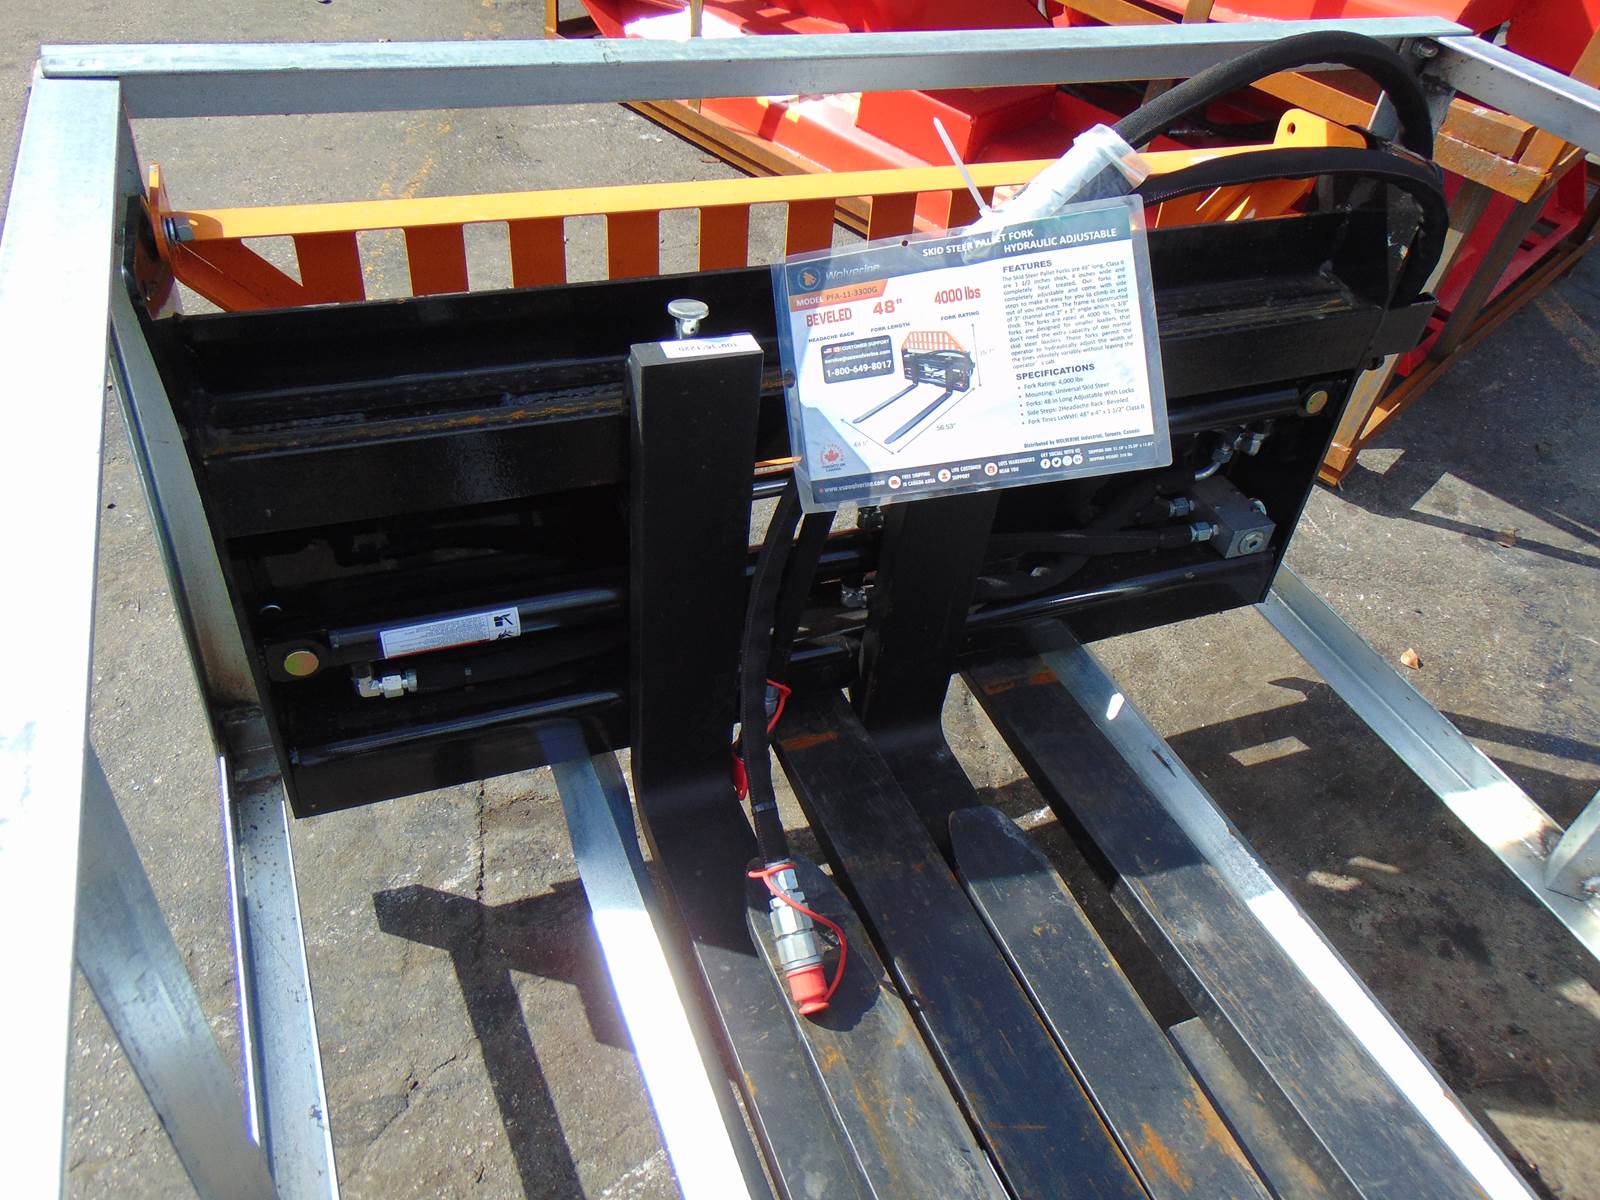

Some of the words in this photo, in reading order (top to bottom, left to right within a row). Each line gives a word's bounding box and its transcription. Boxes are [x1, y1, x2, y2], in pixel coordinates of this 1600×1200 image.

[923, 247, 944, 257] SKID
[945, 240, 973, 254] STEER
[1008, 229, 1034, 241] FORK
[1004, 236, 1057, 253] HYDRAULIC
[1059, 228, 1117, 244] ADJUSTABLE
[826, 264, 880, 280] Wolverine
[1003, 260, 1052, 273] FEATURES
[796, 296, 824, 307] MODEL
[934, 288, 963, 304] 4000
[964, 286, 981, 300] lbs
[806, 307, 852, 327] BEVELED
[887, 322, 911, 330] LENGTH
[808, 335, 838, 343] HEADACHE
[842, 343, 867, 351] CUSTOMER
[868, 339, 889, 347] SUPPORT
[826, 360, 891, 377] 1-800-649-8017
[1016, 363, 1095, 380] SPECIFICATIONS
